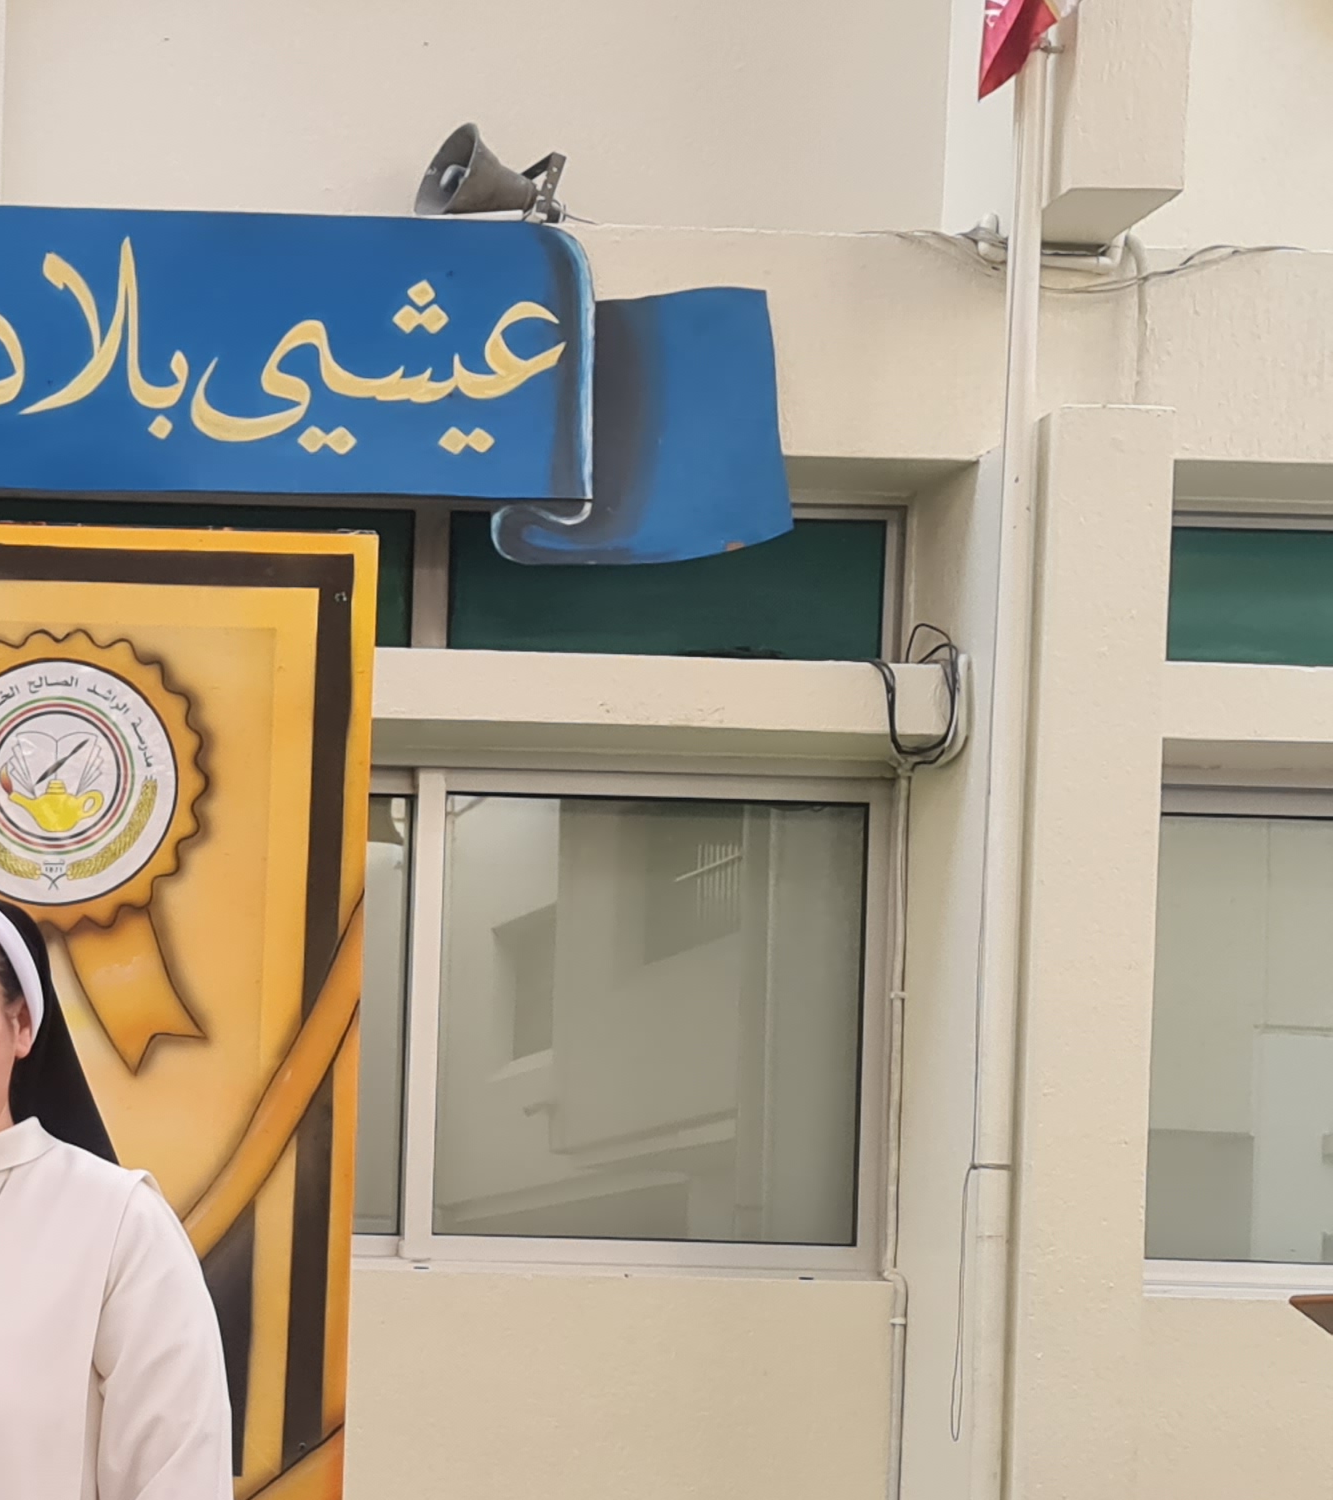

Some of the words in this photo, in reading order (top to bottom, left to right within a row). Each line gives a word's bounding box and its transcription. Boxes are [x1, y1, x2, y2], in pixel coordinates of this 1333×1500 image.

[190, 278, 568, 456] عيشي
[27, 675, 80, 694] الصالح
[86, 683, 131, 715] الراشد
[130, 717, 153, 769] مدرسة
